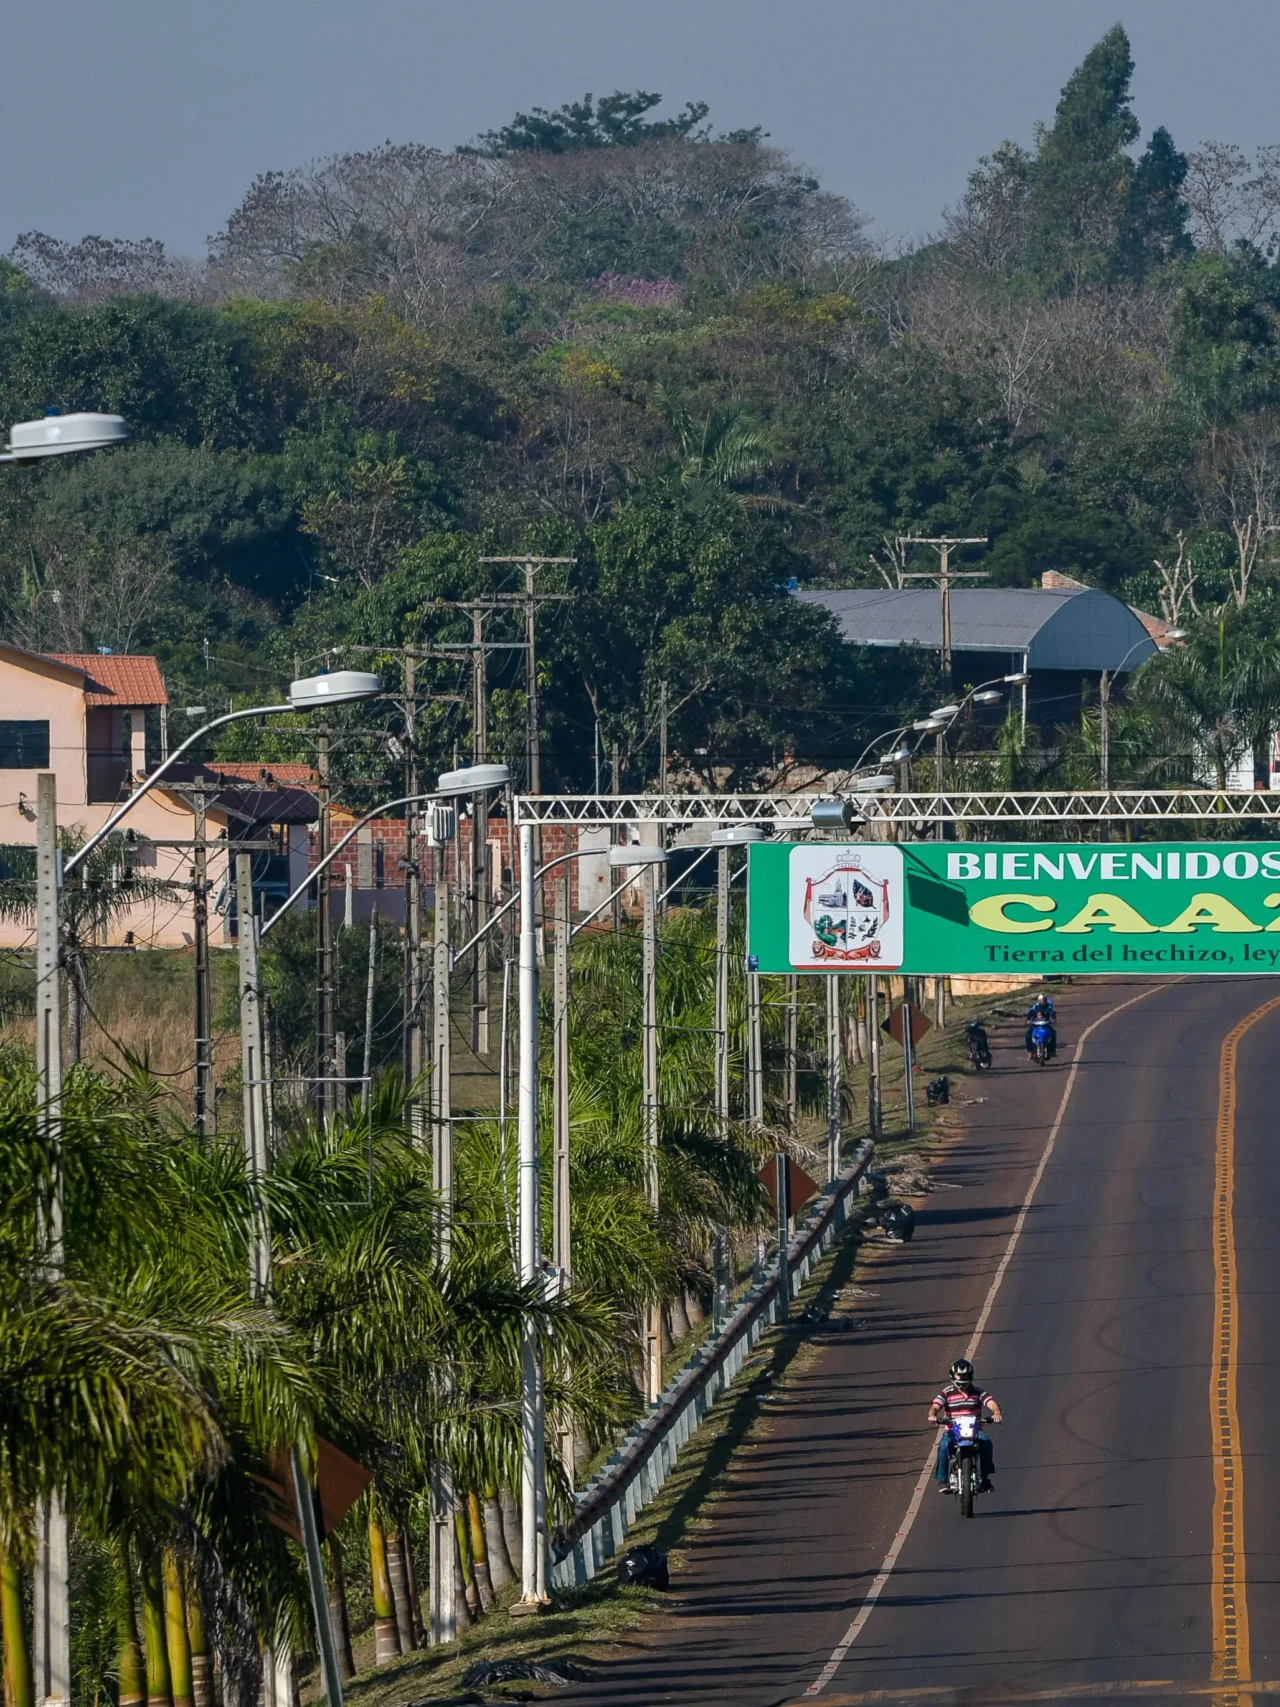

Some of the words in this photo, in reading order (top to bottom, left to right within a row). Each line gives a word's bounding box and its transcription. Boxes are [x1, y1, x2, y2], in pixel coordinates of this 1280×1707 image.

[984, 945, 1064, 962] Tierra
[1071, 944, 1112, 962] del
[1122, 944, 1234, 964] hechizo,
